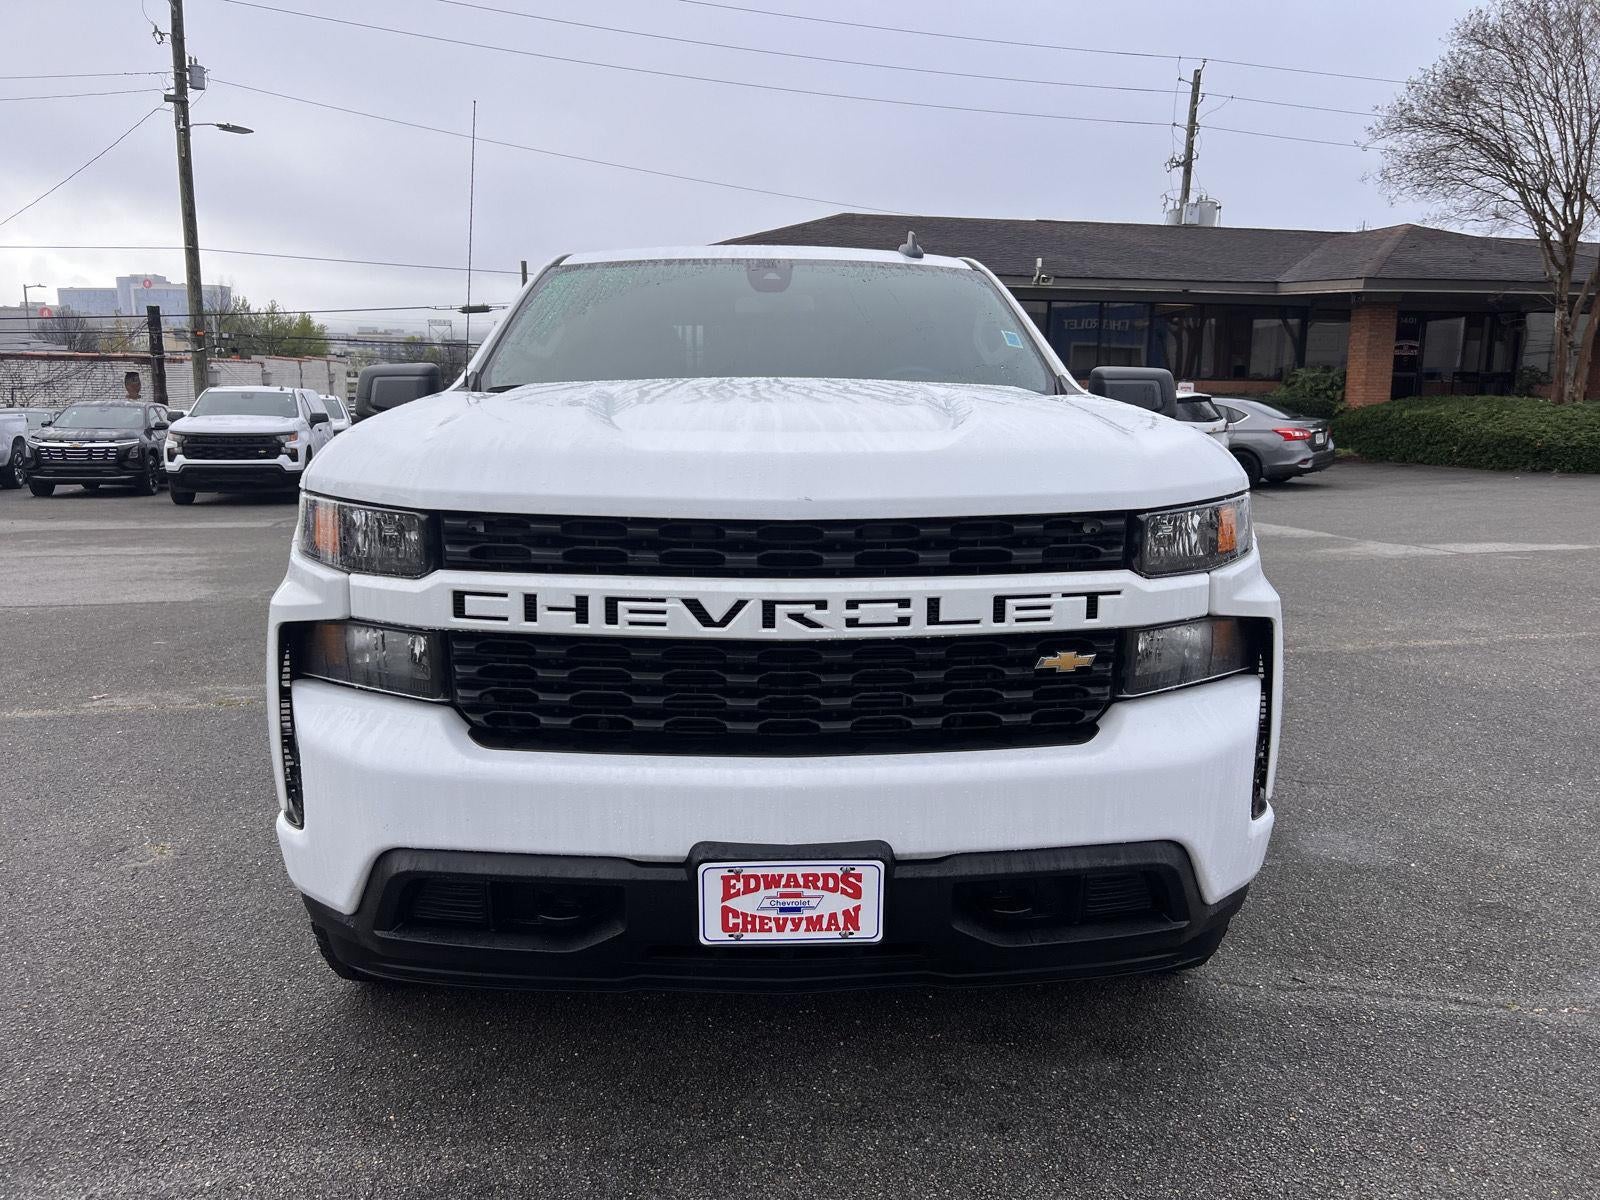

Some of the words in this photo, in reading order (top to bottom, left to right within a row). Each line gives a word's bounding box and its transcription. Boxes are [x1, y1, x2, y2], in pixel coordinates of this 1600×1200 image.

[453, 589, 1122, 629] CHEVROLET
[721, 872, 863, 904] EDWARDS
[769, 899, 811, 907] Chevrolet
[721, 904, 862, 934] CHEVYMAN
